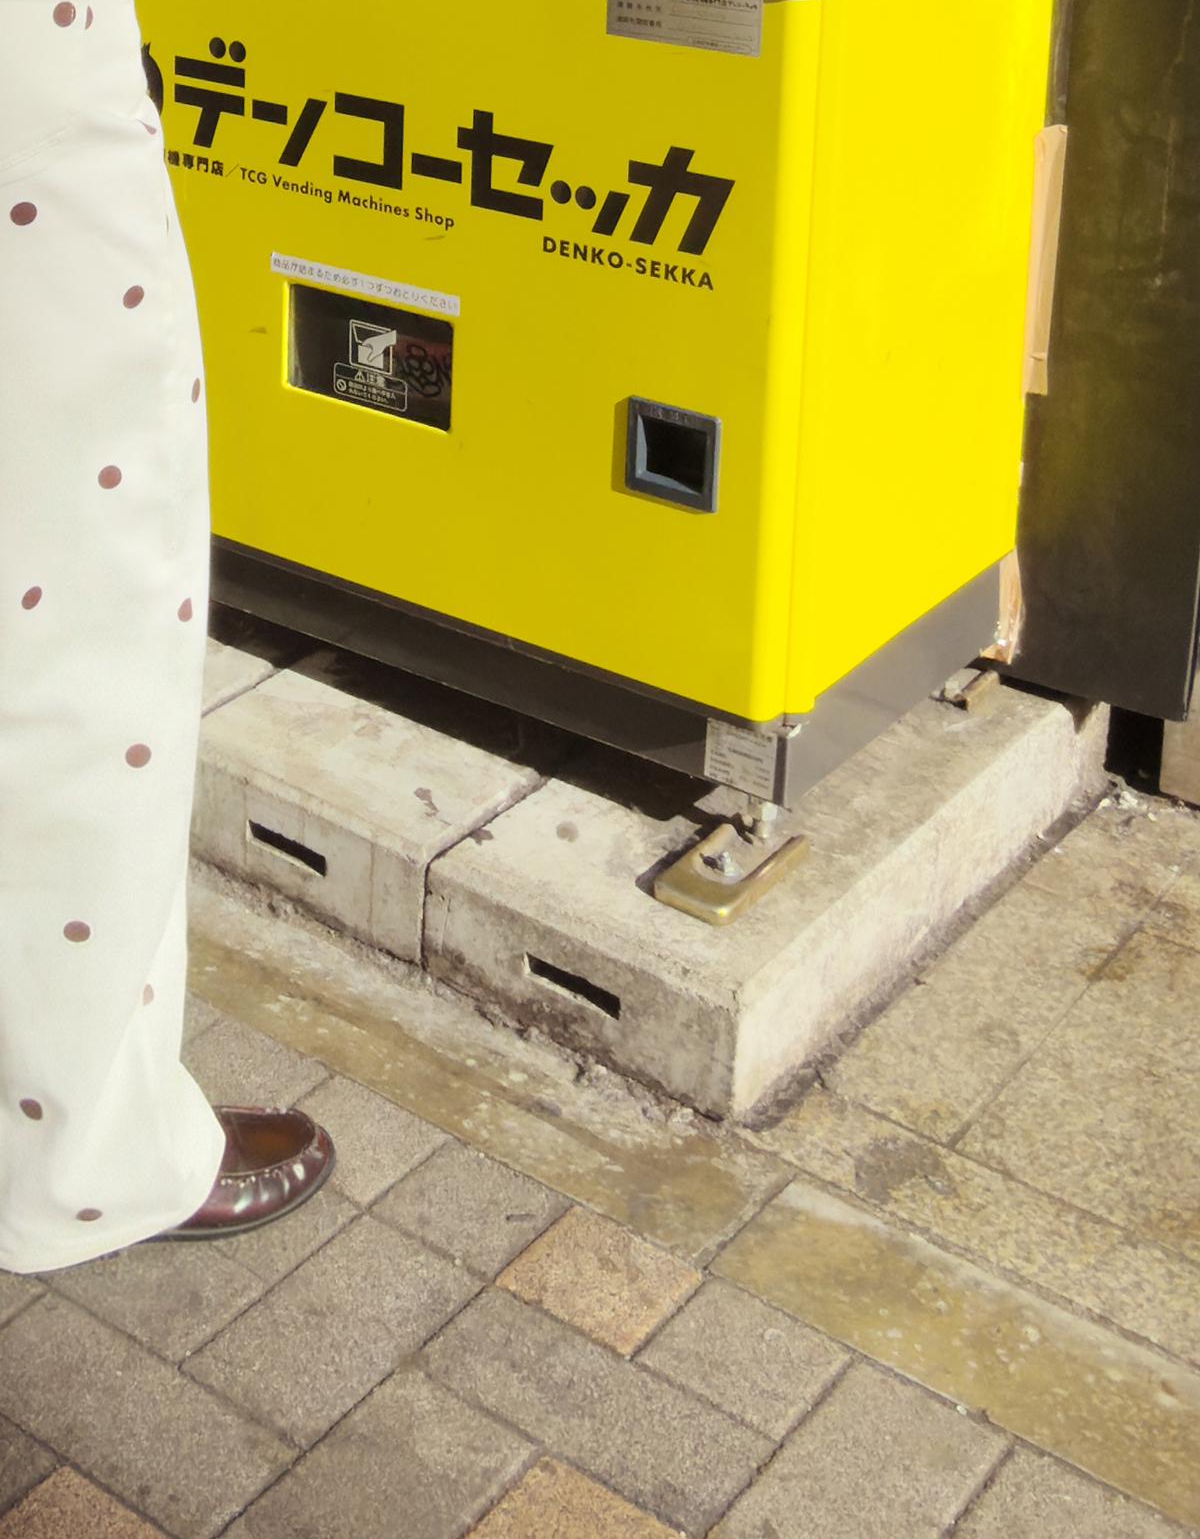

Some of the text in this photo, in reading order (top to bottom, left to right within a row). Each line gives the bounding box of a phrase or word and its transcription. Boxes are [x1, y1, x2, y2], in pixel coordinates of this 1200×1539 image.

[174, 37, 736, 257] デンコーセッカ
[240, 167, 267, 184] TCG
[273, 174, 333, 203] Vending
[338, 190, 410, 218] Machines
[415, 207, 455, 230] Shop
[542, 236, 715, 291] DENKO-SEKKA
